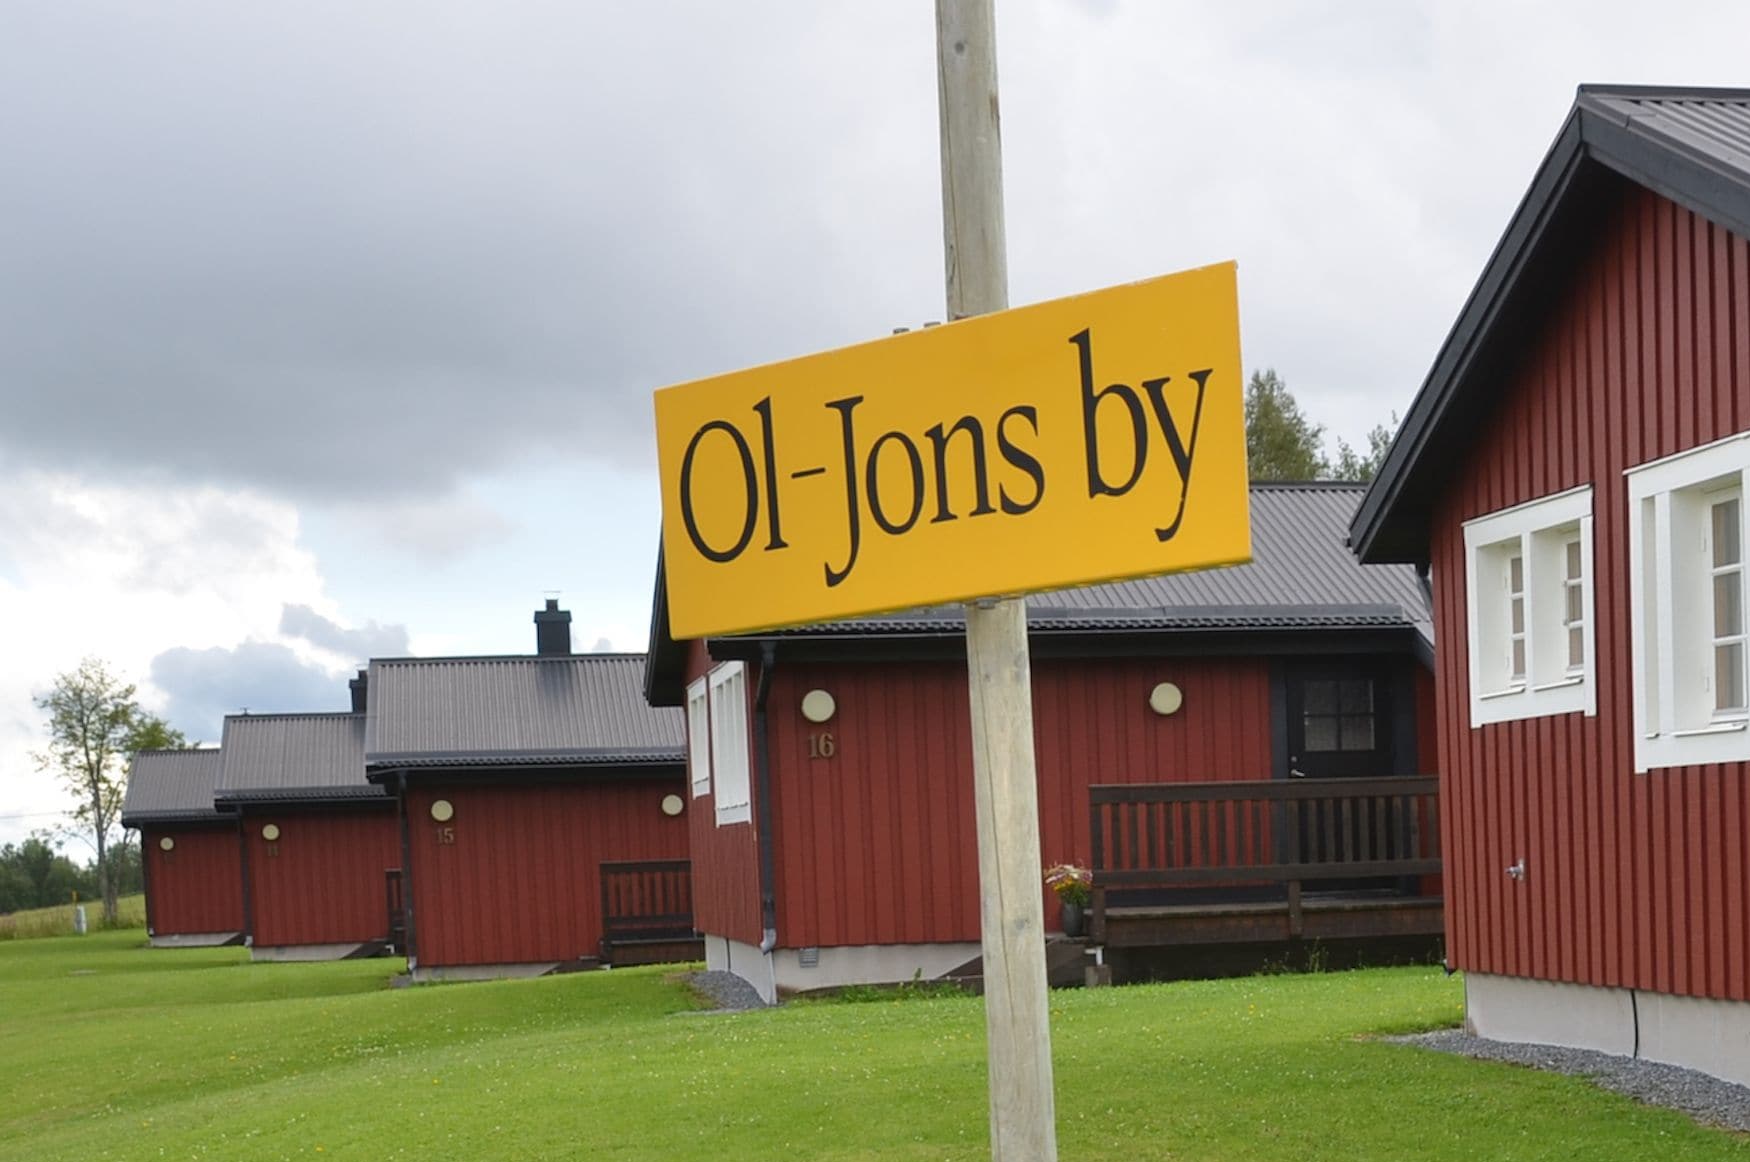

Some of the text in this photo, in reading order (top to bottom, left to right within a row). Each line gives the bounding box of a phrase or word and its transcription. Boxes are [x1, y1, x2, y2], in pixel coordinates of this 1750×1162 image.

[679, 327, 1214, 588] Ol-Jons by
[808, 733, 835, 758] 16
